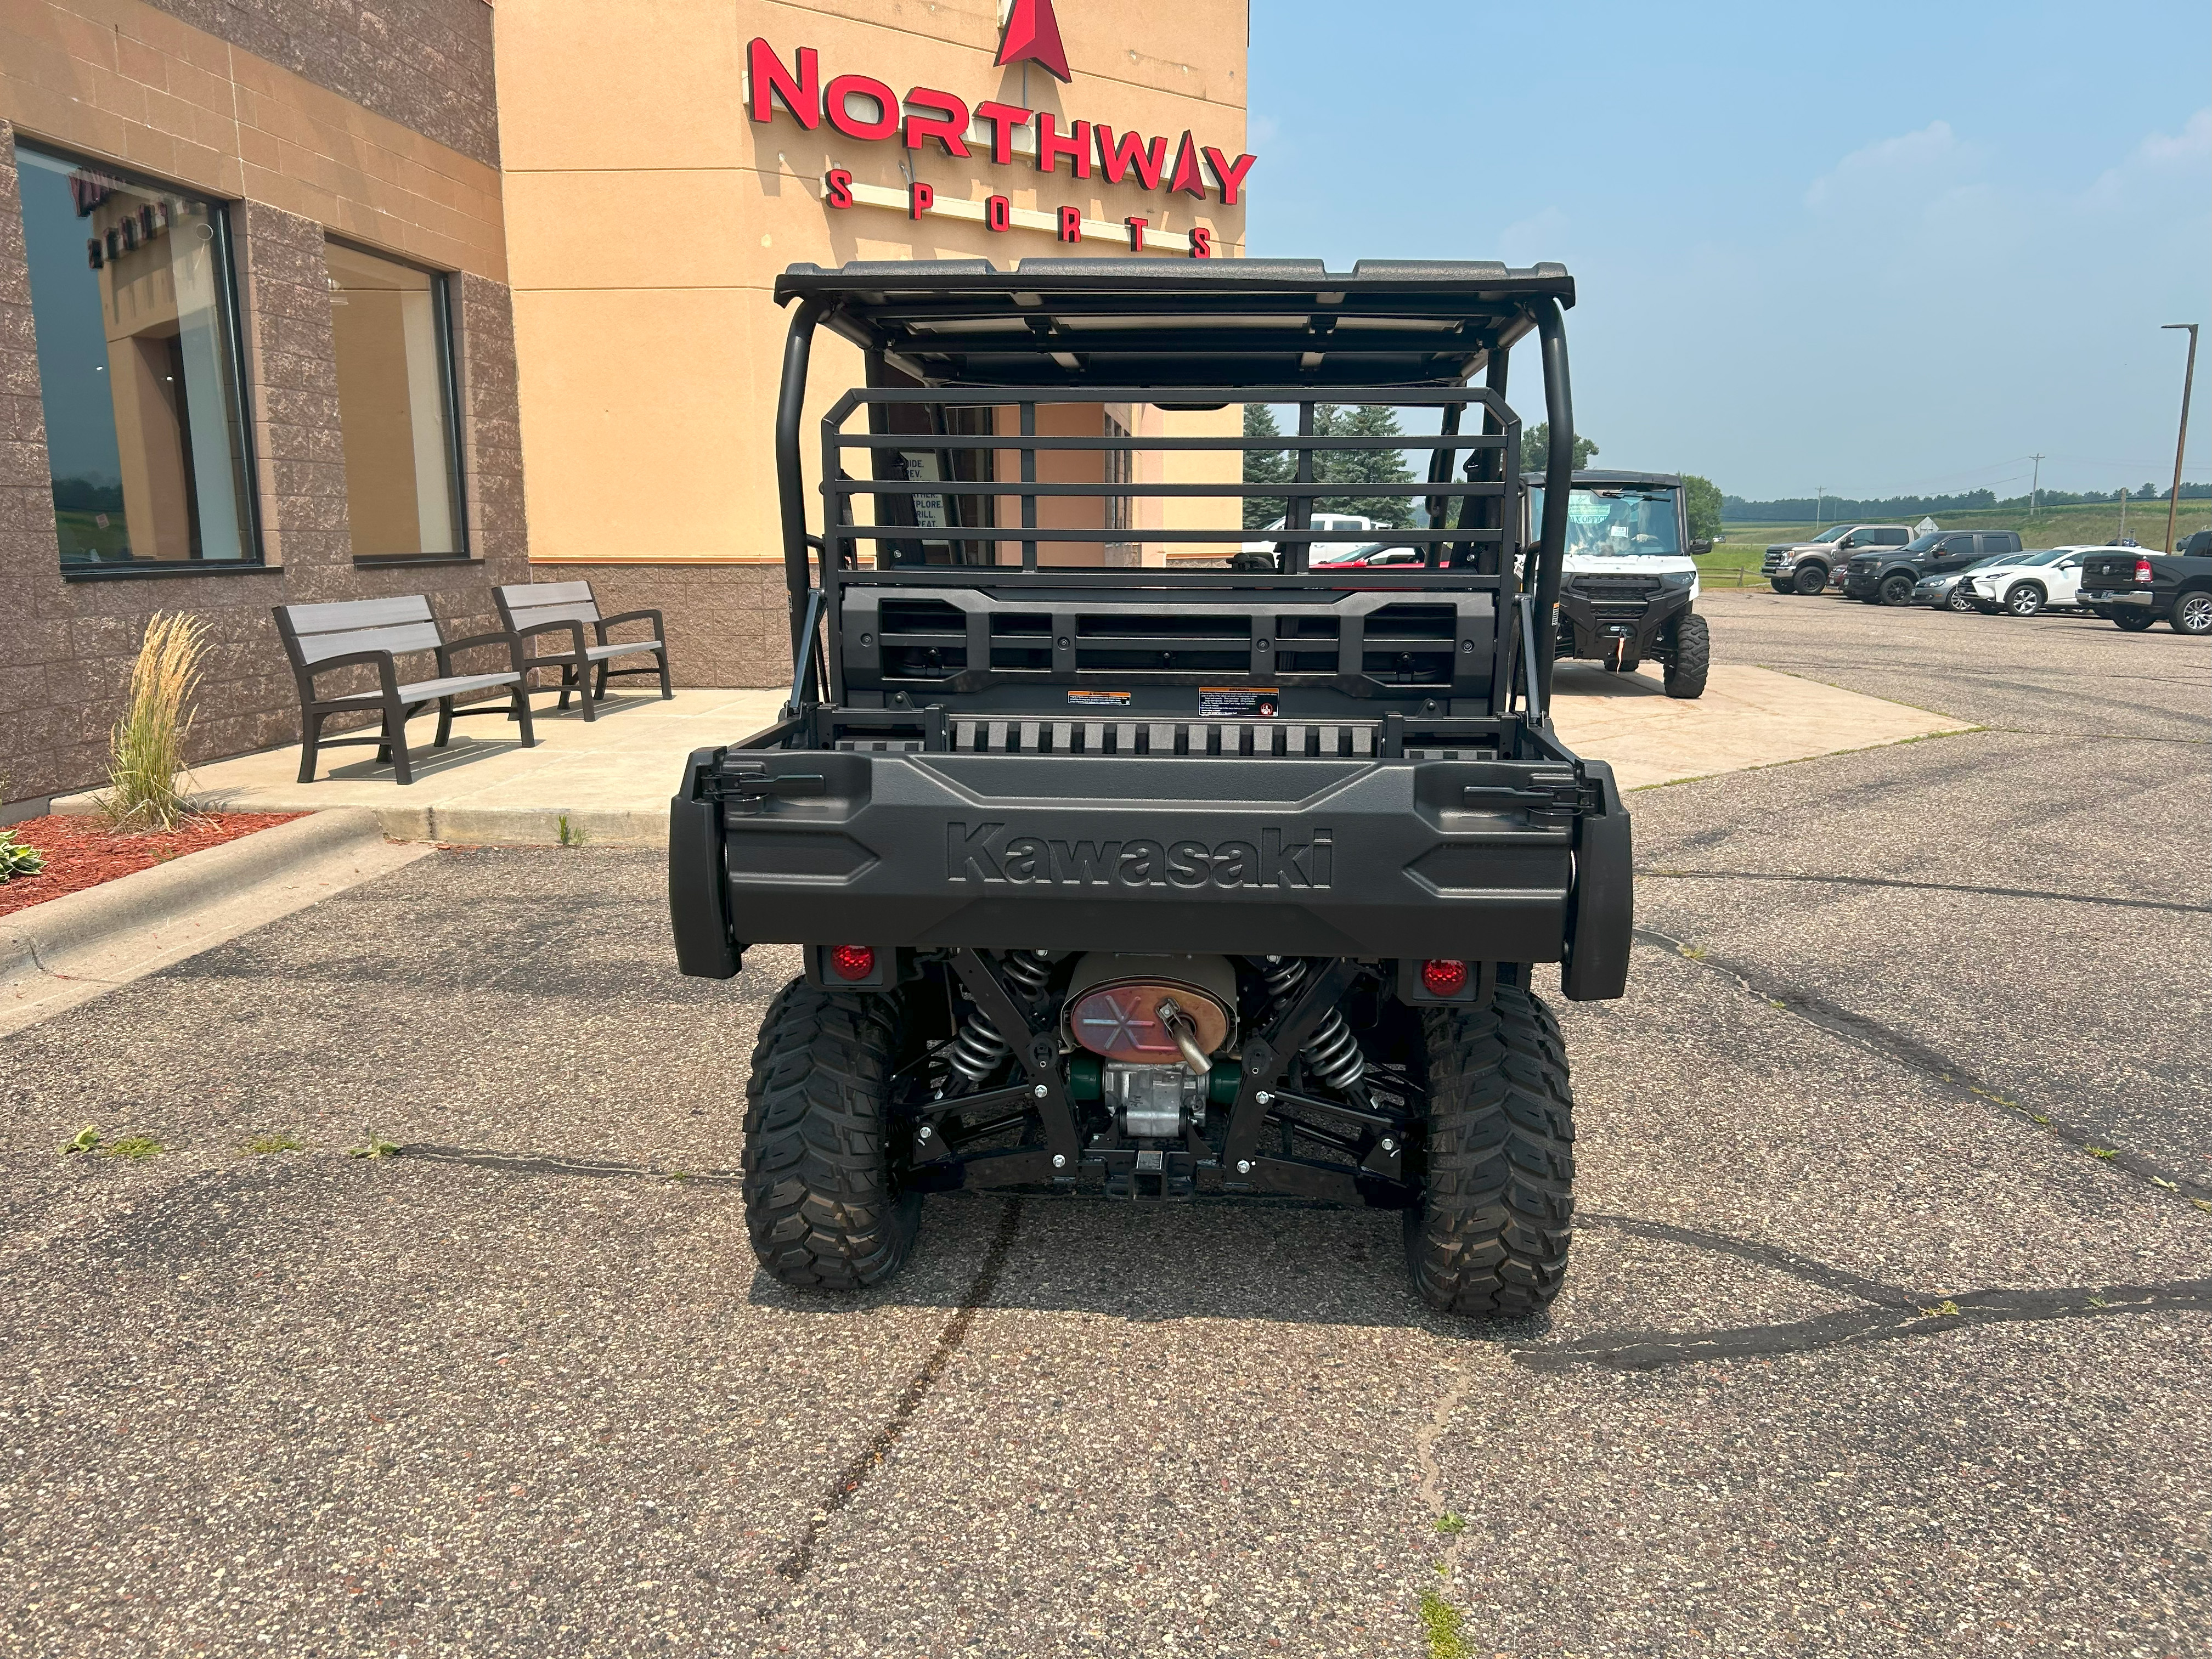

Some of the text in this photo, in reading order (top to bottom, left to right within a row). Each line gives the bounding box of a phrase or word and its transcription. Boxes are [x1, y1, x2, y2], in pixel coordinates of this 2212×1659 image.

[826, 169, 1211, 259] SPORTS
[917, 510, 936, 518] RILL.
[947, 822, 1333, 889] Kawasaki
